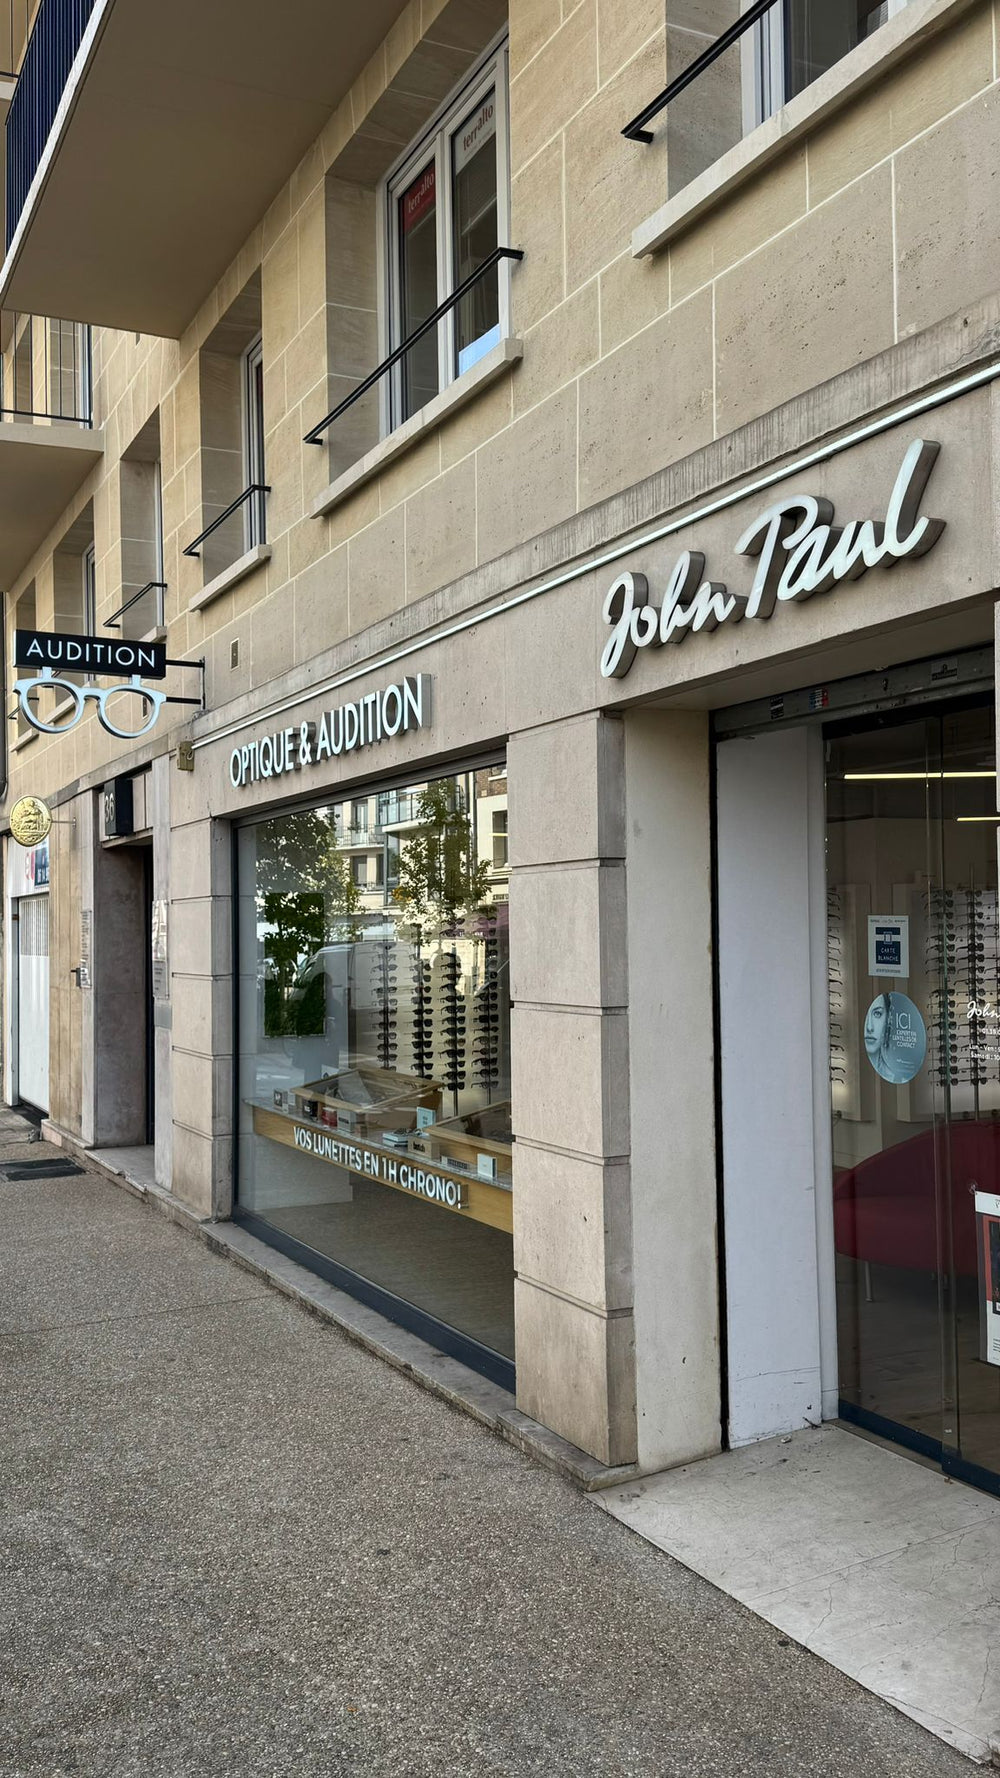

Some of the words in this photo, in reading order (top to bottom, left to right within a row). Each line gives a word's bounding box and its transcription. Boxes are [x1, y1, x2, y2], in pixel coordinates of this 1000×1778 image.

[600, 550, 737, 679] John
[734, 438, 931, 619] Paul
[26, 638, 155, 668] AUDITION
[229, 726, 294, 788] OPTIQUE
[299, 720, 313, 766] &
[316, 672, 423, 761] AUDITION
[105, 792, 115, 823] 36
[896, 1012, 911, 1030] ICI
[293, 1126, 312, 1150] VOS
[313, 1132, 362, 1171] LUNETTES
[363, 1151, 379, 1177] EN
[381, 1157, 398, 1184] 1H
[400, 1164, 462, 1210] CHRONO!
